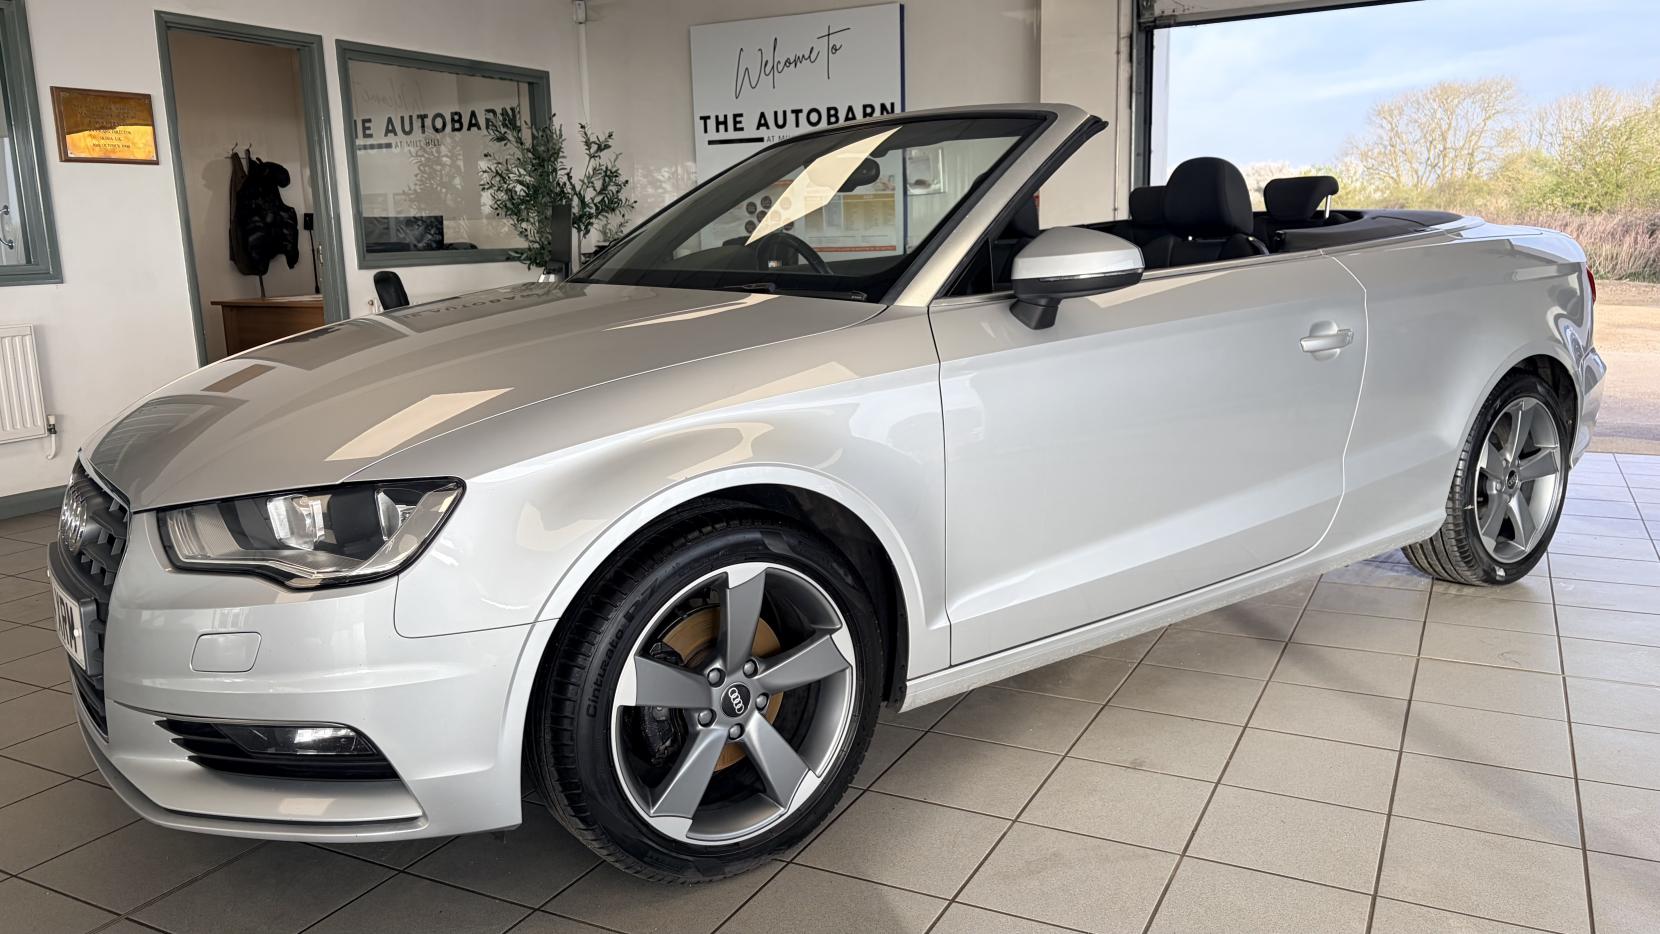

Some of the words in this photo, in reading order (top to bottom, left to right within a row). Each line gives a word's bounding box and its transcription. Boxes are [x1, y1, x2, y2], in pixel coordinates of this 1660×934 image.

[735, 36, 820, 99] Welcome
[817, 25, 851, 80] to
[700, 113, 744, 134] THE
[756, 102, 895, 130] AUTOBARN
[586, 628, 625, 718] Cinturato
